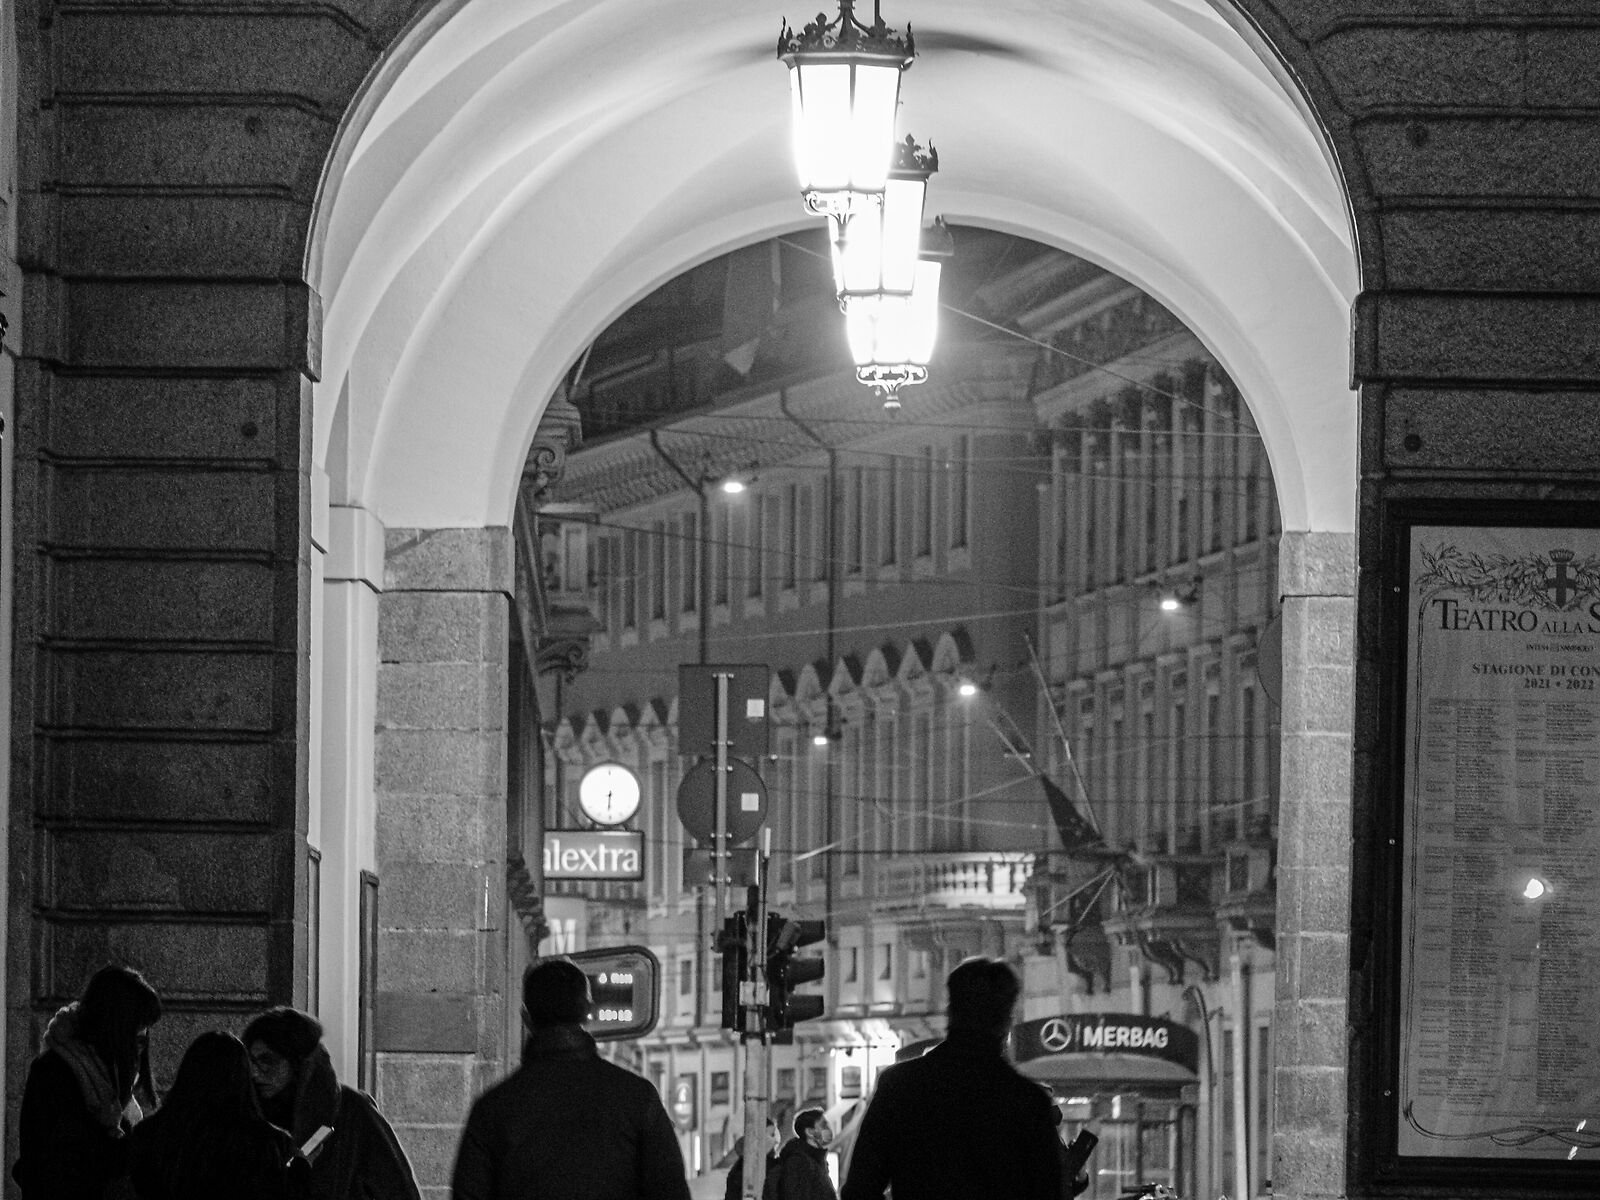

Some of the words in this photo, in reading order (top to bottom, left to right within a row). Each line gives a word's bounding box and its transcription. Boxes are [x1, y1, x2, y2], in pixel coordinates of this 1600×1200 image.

[1432, 599, 1538, 633] TEATRO
[1541, 621, 1583, 634] ALLA
[1472, 663, 1545, 676] STAGIONE
[1550, 665, 1566, 677] DI
[1524, 678, 1551, 689] 2021
[1566, 679, 1594, 690] 2022
[1083, 1025, 1169, 1049] MERBAG
